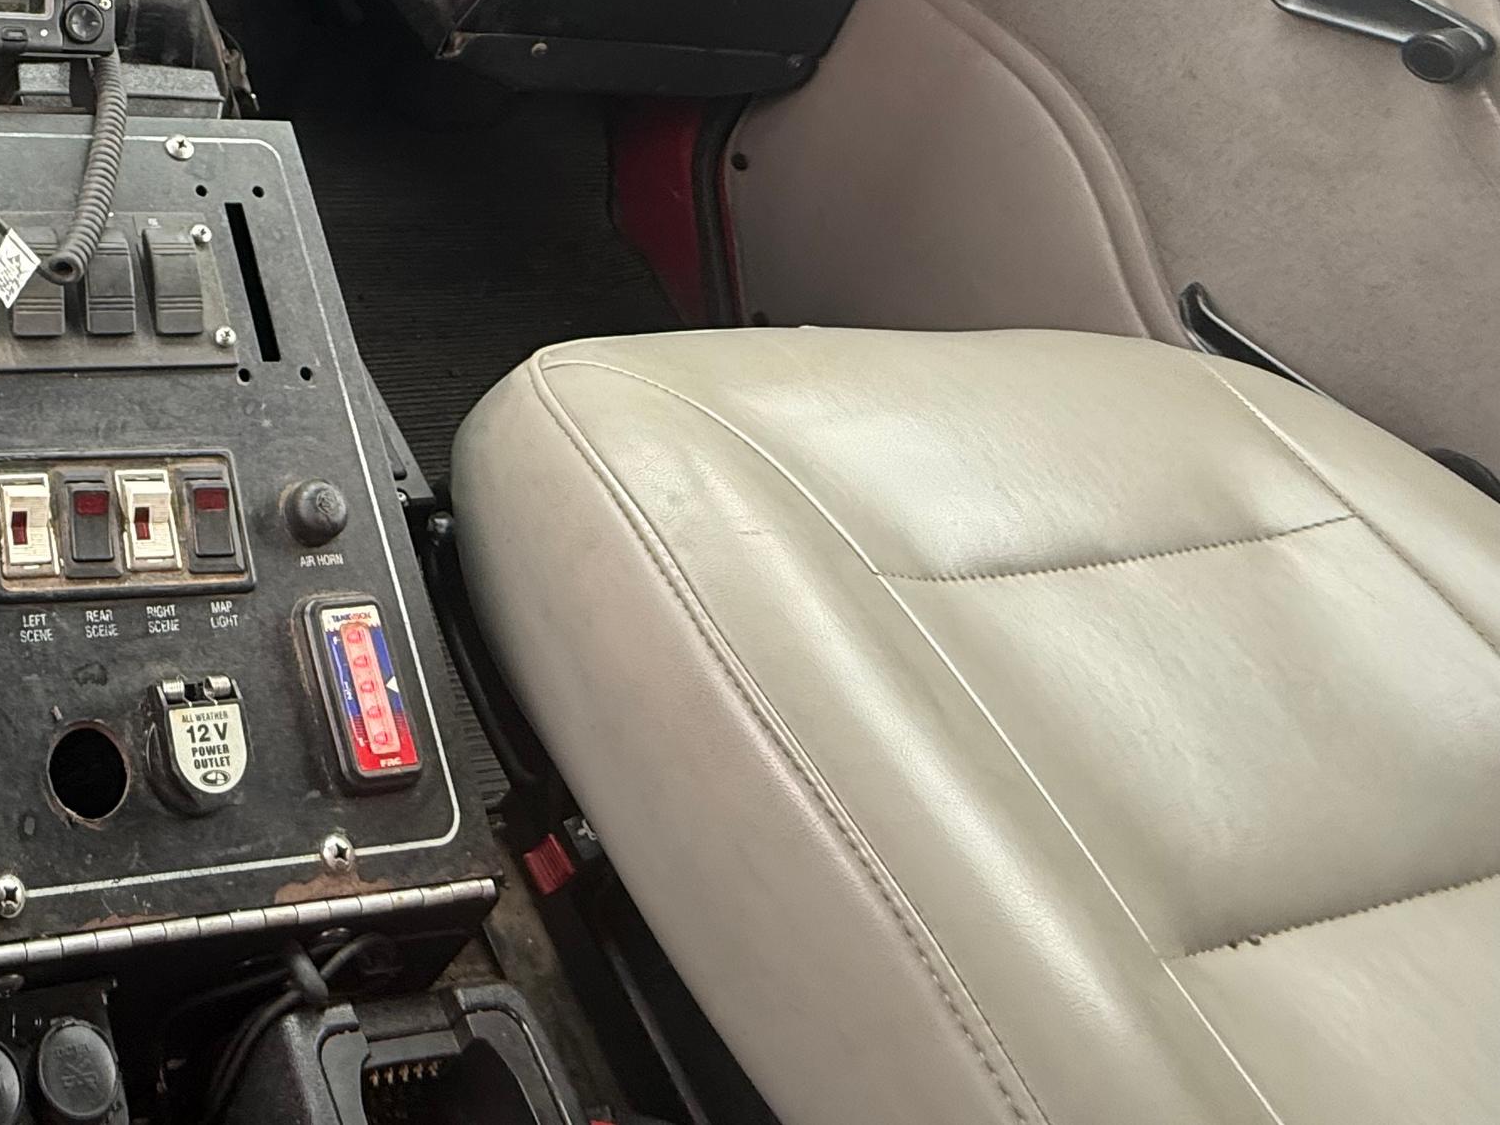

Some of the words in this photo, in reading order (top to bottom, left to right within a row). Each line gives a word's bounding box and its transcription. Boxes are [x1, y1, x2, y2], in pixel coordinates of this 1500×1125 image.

[300, 555, 316, 568] AIR
[317, 553, 344, 566] HORN
[146, 604, 176, 618] RIGHT
[210, 600, 233, 614] MAP
[22, 613, 47, 628] LEFT
[85, 609, 113, 622] REAR
[210, 614, 239, 629] LIGHT
[84, 624, 119, 639] SCENE
[148, 619, 180, 634] SCENE
[19, 628, 54, 643] SCENE
[181, 714, 194, 723] ALL
[195, 710, 229, 722] WEATHER
[186, 724, 211, 744] 12
[213, 722, 228, 741] V
[191, 743, 230, 758] POWER
[193, 755, 231, 770] OUTLET
[380, 758, 402, 768] FRC
